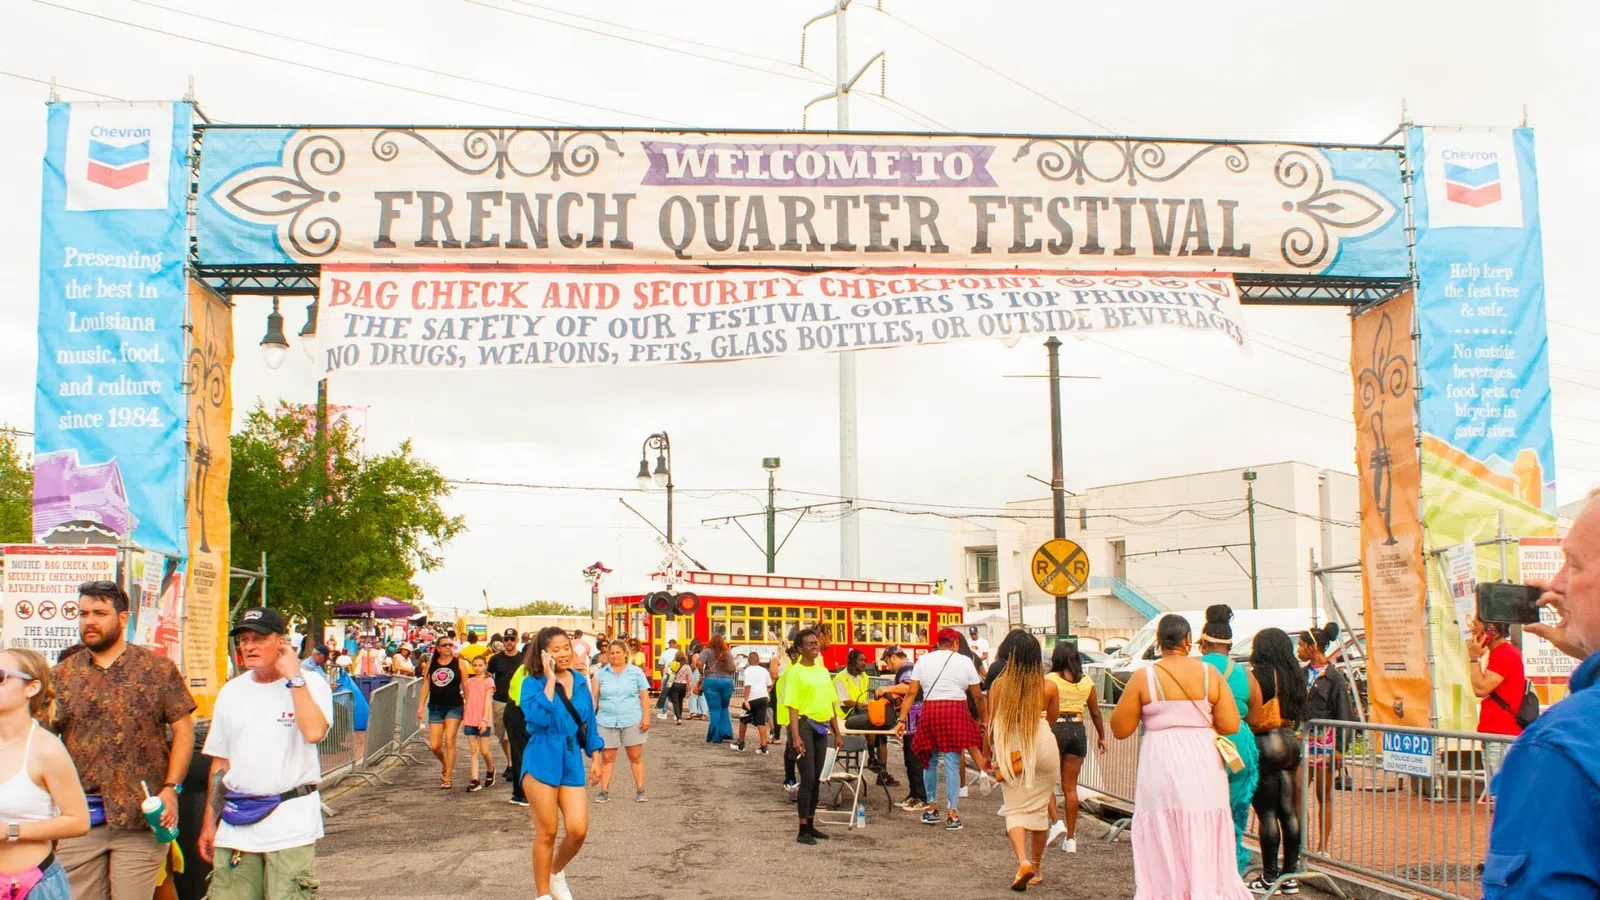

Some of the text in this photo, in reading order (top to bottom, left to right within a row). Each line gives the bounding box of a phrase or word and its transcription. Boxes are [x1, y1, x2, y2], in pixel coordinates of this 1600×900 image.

[90, 125, 151, 139] Chevron
[1442, 149, 1498, 161] Chevron
[663, 147, 974, 181] WELCOME TO
[373, 190, 1251, 259] FRENCH QUARTER FESTIVAL
[63, 247, 163, 273] Presenting
[1449, 261, 1514, 281] Help keep
[65, 277, 159, 299] the best in
[328, 276, 1045, 309] BAG CHECK AND SECURITY CHECKPOINT
[1444, 281, 1520, 298] the fest free
[343, 289, 1225, 341] THE SAFETY OF OUR FESTIVAL GOERS IS TOP PRIORITY
[1460, 301, 1507, 317] & safe.
[67, 311, 156, 333] Louisiana
[325, 307, 1244, 372] NO DRUGS, WEAPONS, PETS, GLASS BOTTLES, OR OUTSIDE BEVERAGES
[1452, 343, 1515, 359] No outside
[59, 374, 162, 396] and culture
[1510, 387, 1521, 399] or
[58, 406, 165, 429] since 1984.
[1455, 402, 1517, 420] bicycles in
[1454, 421, 1485, 440] gated
[45, 561, 60, 570] BAG
[62, 561, 88, 570] CHECK
[91, 561, 109, 570] AND
[1036, 561, 1086, 575] R R
[8, 572, 46, 581] SECURITY
[49, 573, 100, 582] CHECKPOINT
[8, 584, 61, 593] RIVERFRONT
[24, 626, 79, 636] THE SAFETY
[12, 638, 30, 648] OUR
[1390, 754, 1410, 762] POLICE
[1408, 765, 1427, 773] CROSS
